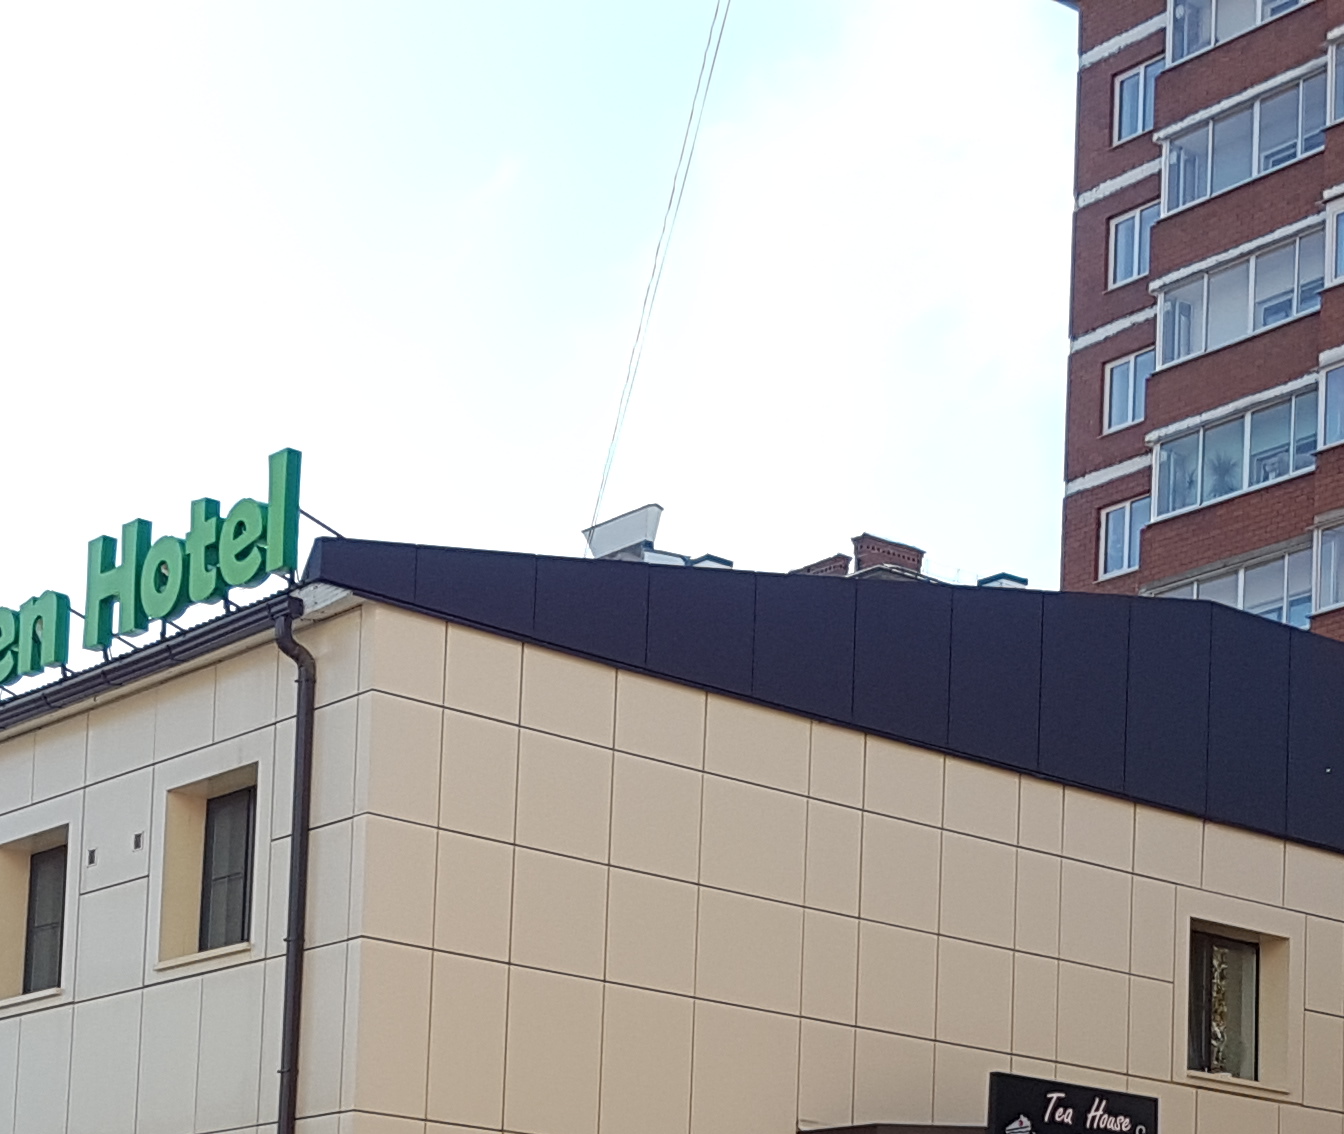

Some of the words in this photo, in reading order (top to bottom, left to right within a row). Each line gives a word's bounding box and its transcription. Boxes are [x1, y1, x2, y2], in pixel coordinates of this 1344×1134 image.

[82, 447, 302, 651] Hotel
[1043, 1092, 1073, 1125] Tea
[1086, 1097, 1132, 1132] House
